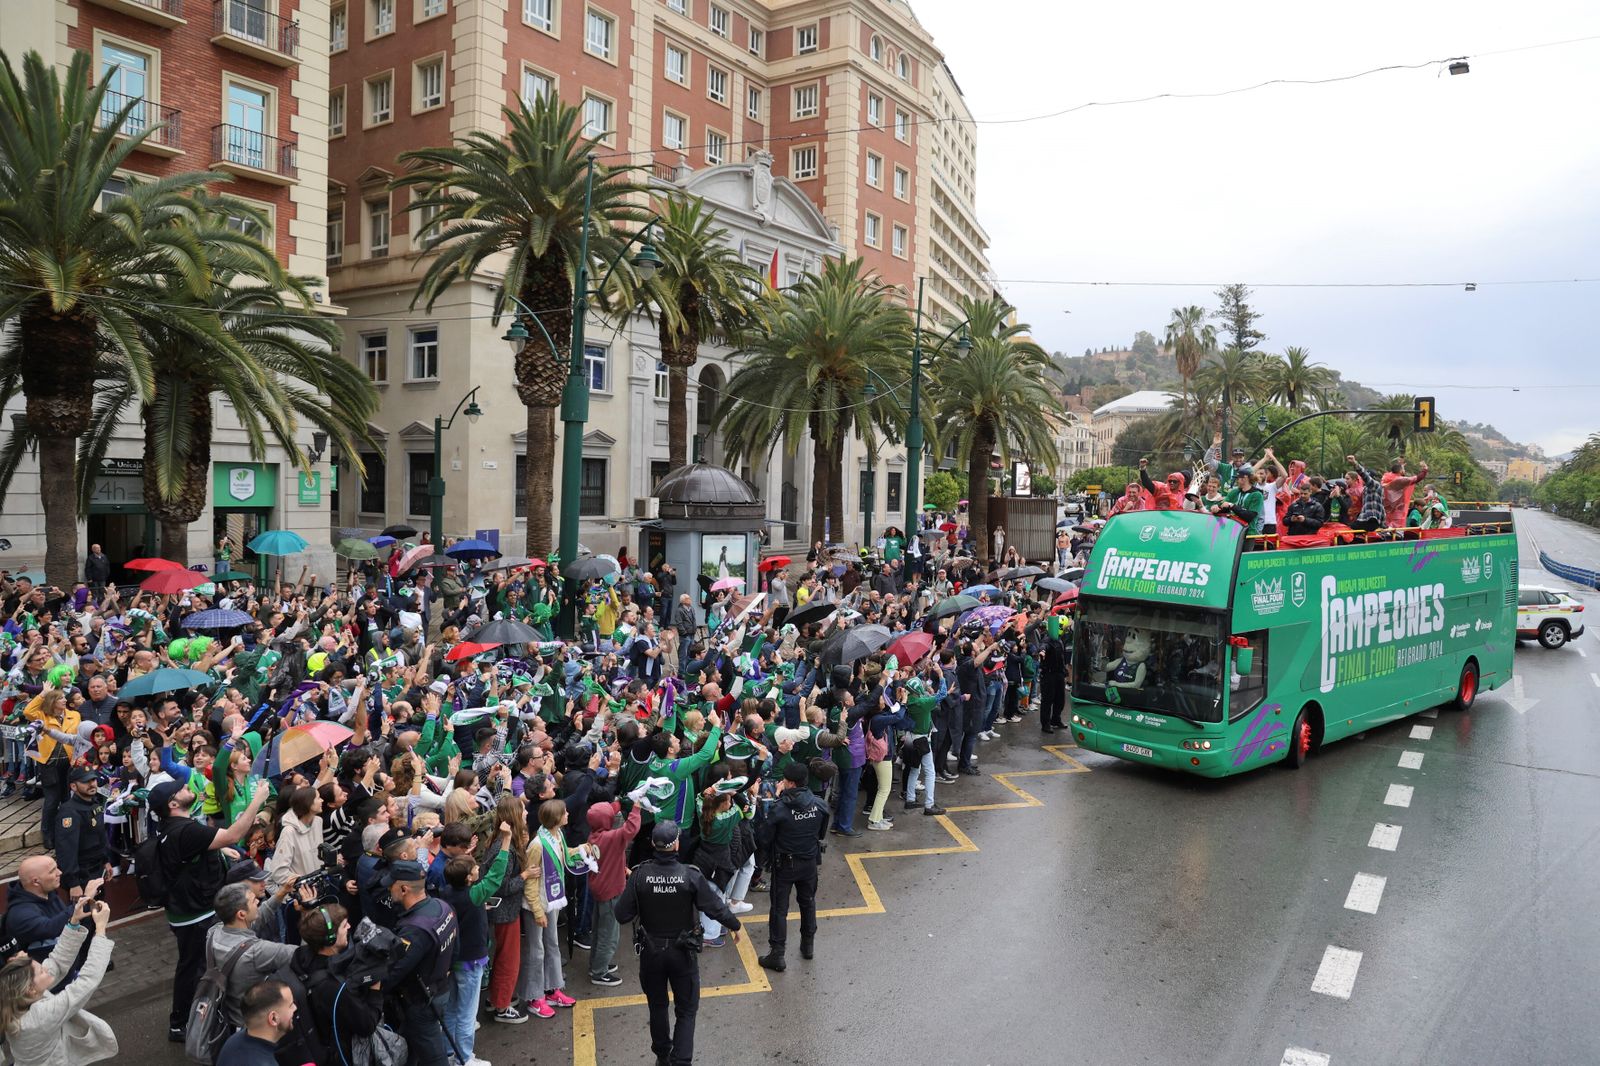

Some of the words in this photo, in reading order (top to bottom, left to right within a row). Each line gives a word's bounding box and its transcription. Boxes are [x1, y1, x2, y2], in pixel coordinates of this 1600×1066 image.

[117, 461, 143, 470] Unicaja
[1096, 547, 1211, 590] CAMPEONES
[1108, 577, 1132, 592] FINAL
[1133, 579, 1156, 594] FOUR
[1157, 584, 1186, 597] BELGRADO
[1188, 587, 1205, 599] 2024
[1253, 595, 1269, 605] FINAL
[1269, 593, 1284, 603] FOUR
[1320, 575, 1445, 693] CAMPEONES
[1336, 651, 1366, 688] FINAL
[1369, 645, 1396, 677] FOUR
[1397, 646, 1427, 670] BELGRADO
[1429, 640, 1444, 661] 2024
[1114, 712, 1132, 721] Unicaja
[794, 812, 816, 821] LOCAL
[646, 874, 666, 884] POLICÍA
[667, 874, 685, 884] LOCAL
[653, 884, 677, 894] MÁLAGA
